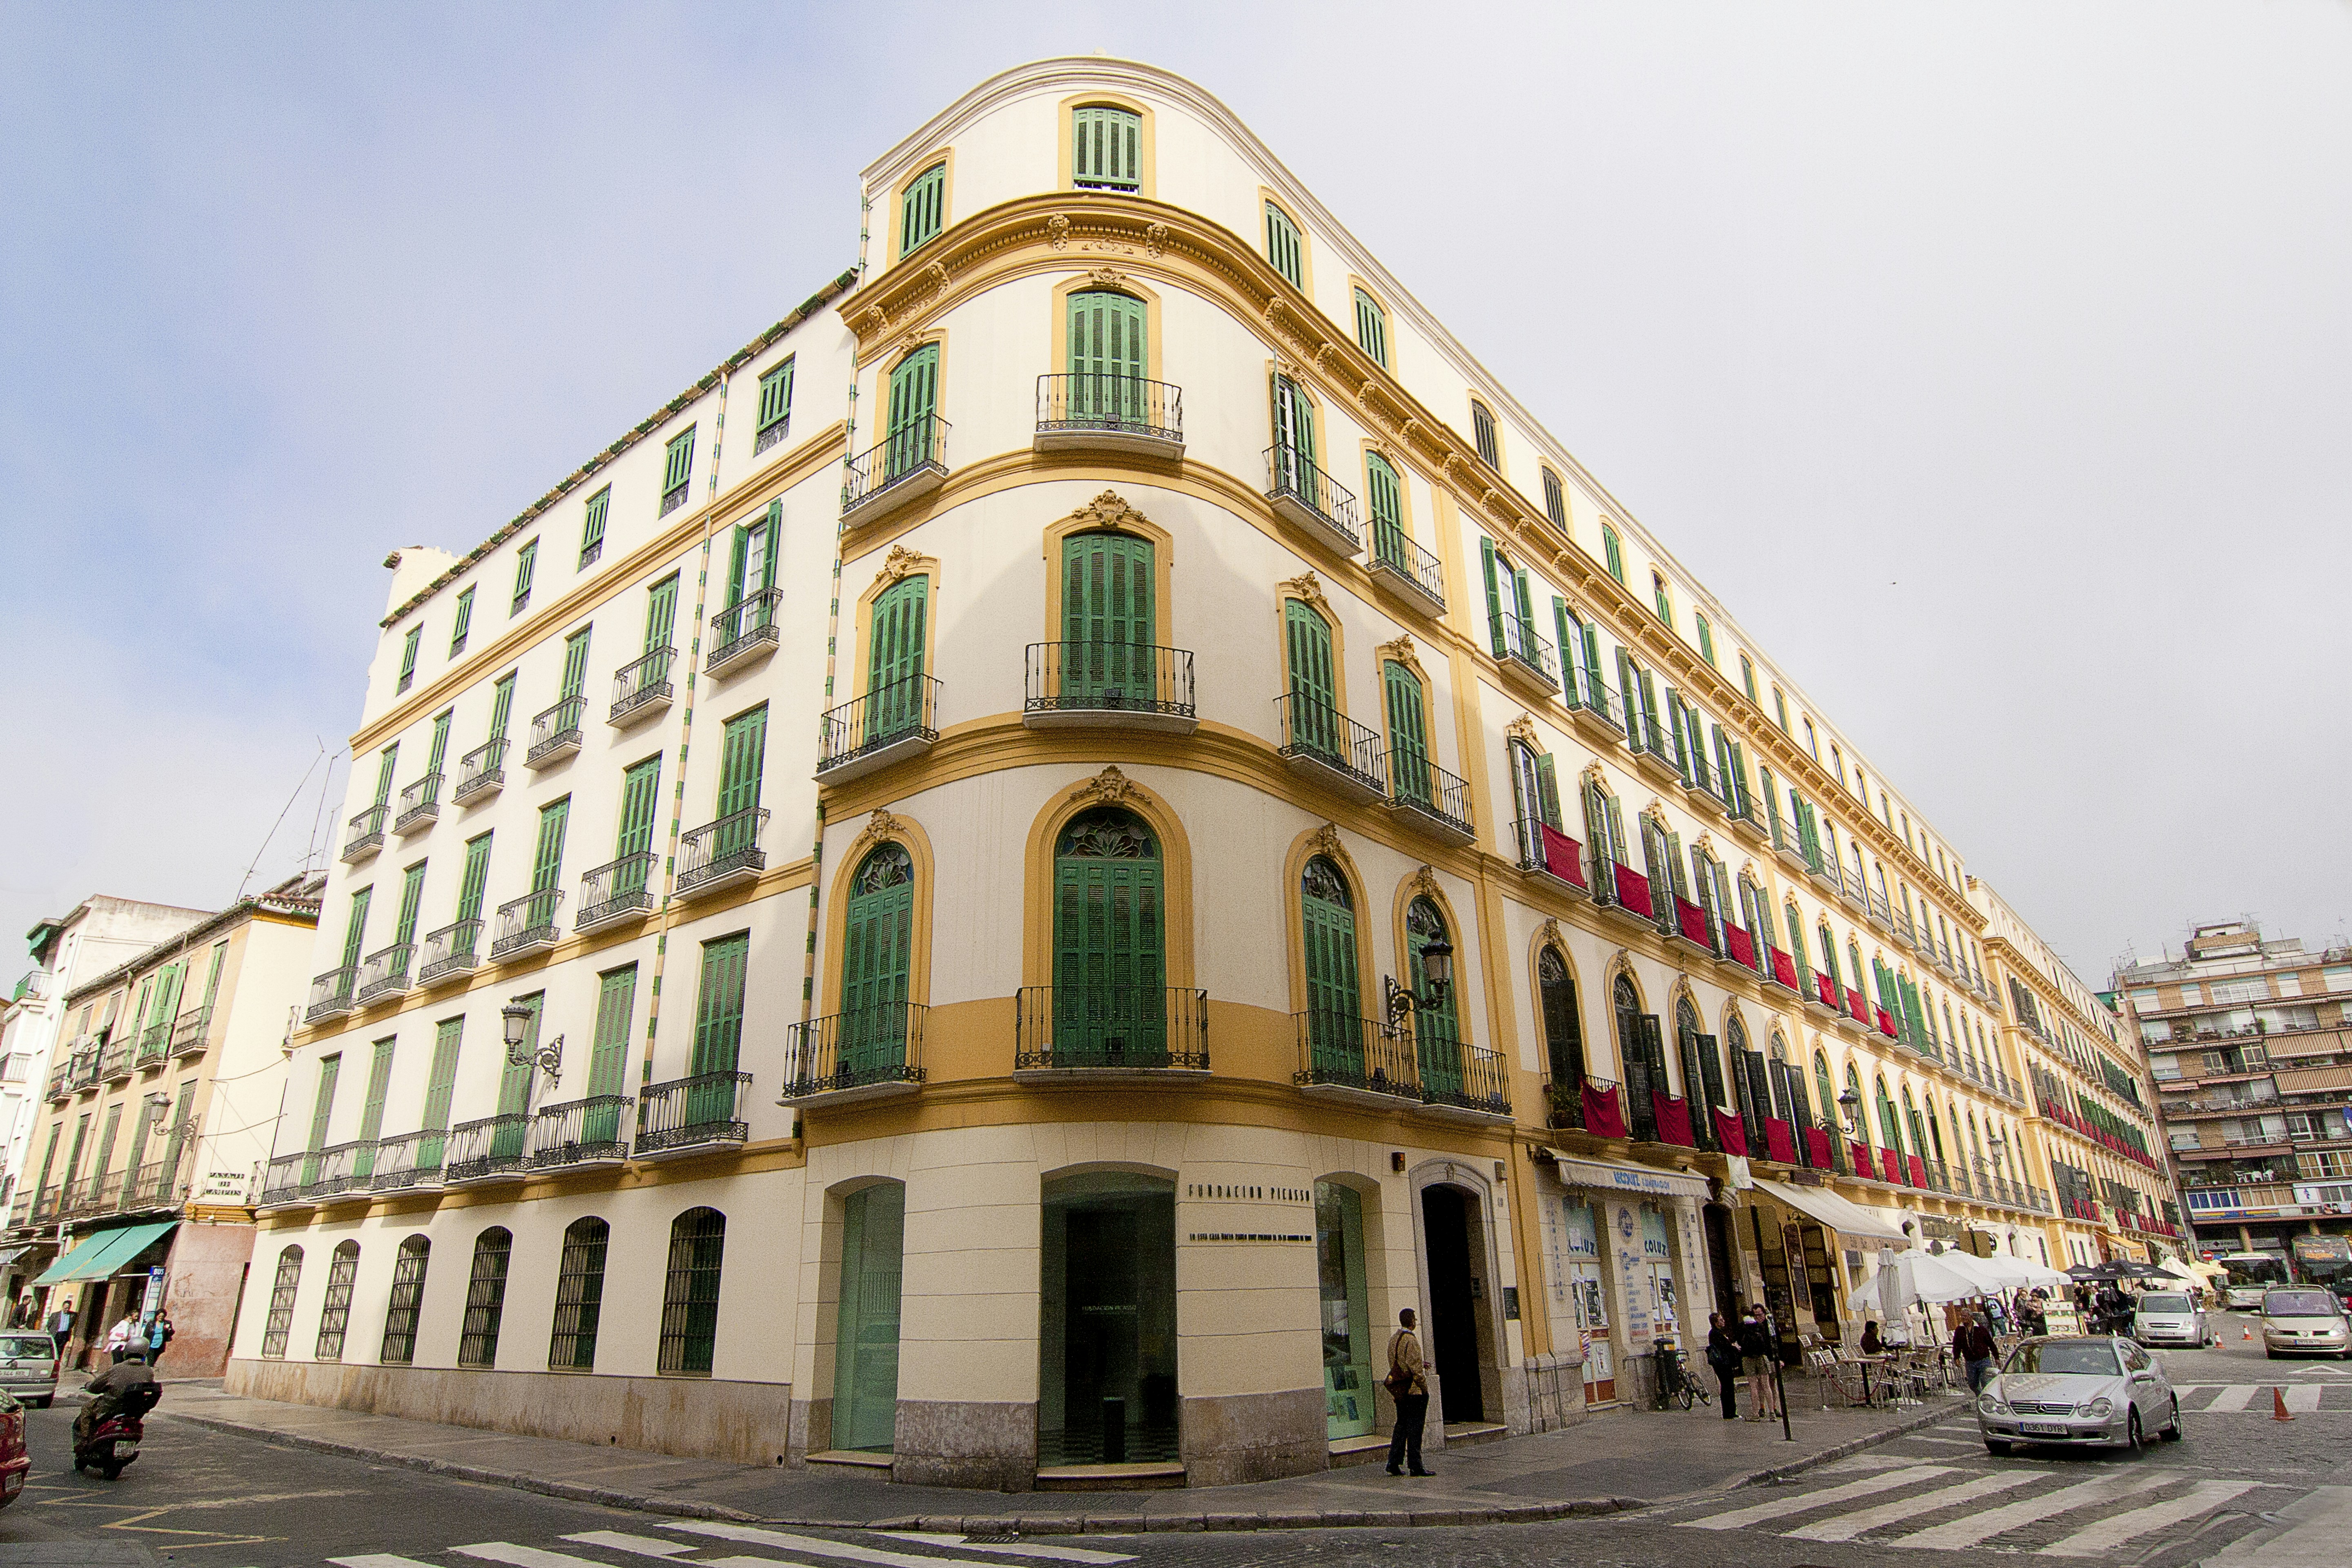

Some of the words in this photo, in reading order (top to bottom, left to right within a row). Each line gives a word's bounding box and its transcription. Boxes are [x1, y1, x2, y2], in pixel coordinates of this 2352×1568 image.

[1189, 1184, 1262, 1198] FUNDACION
[1271, 1187, 1310, 1202] PICASSO
[2025, 1423, 2045, 1432] 0361
[2047, 1423, 2063, 1433] DYR
